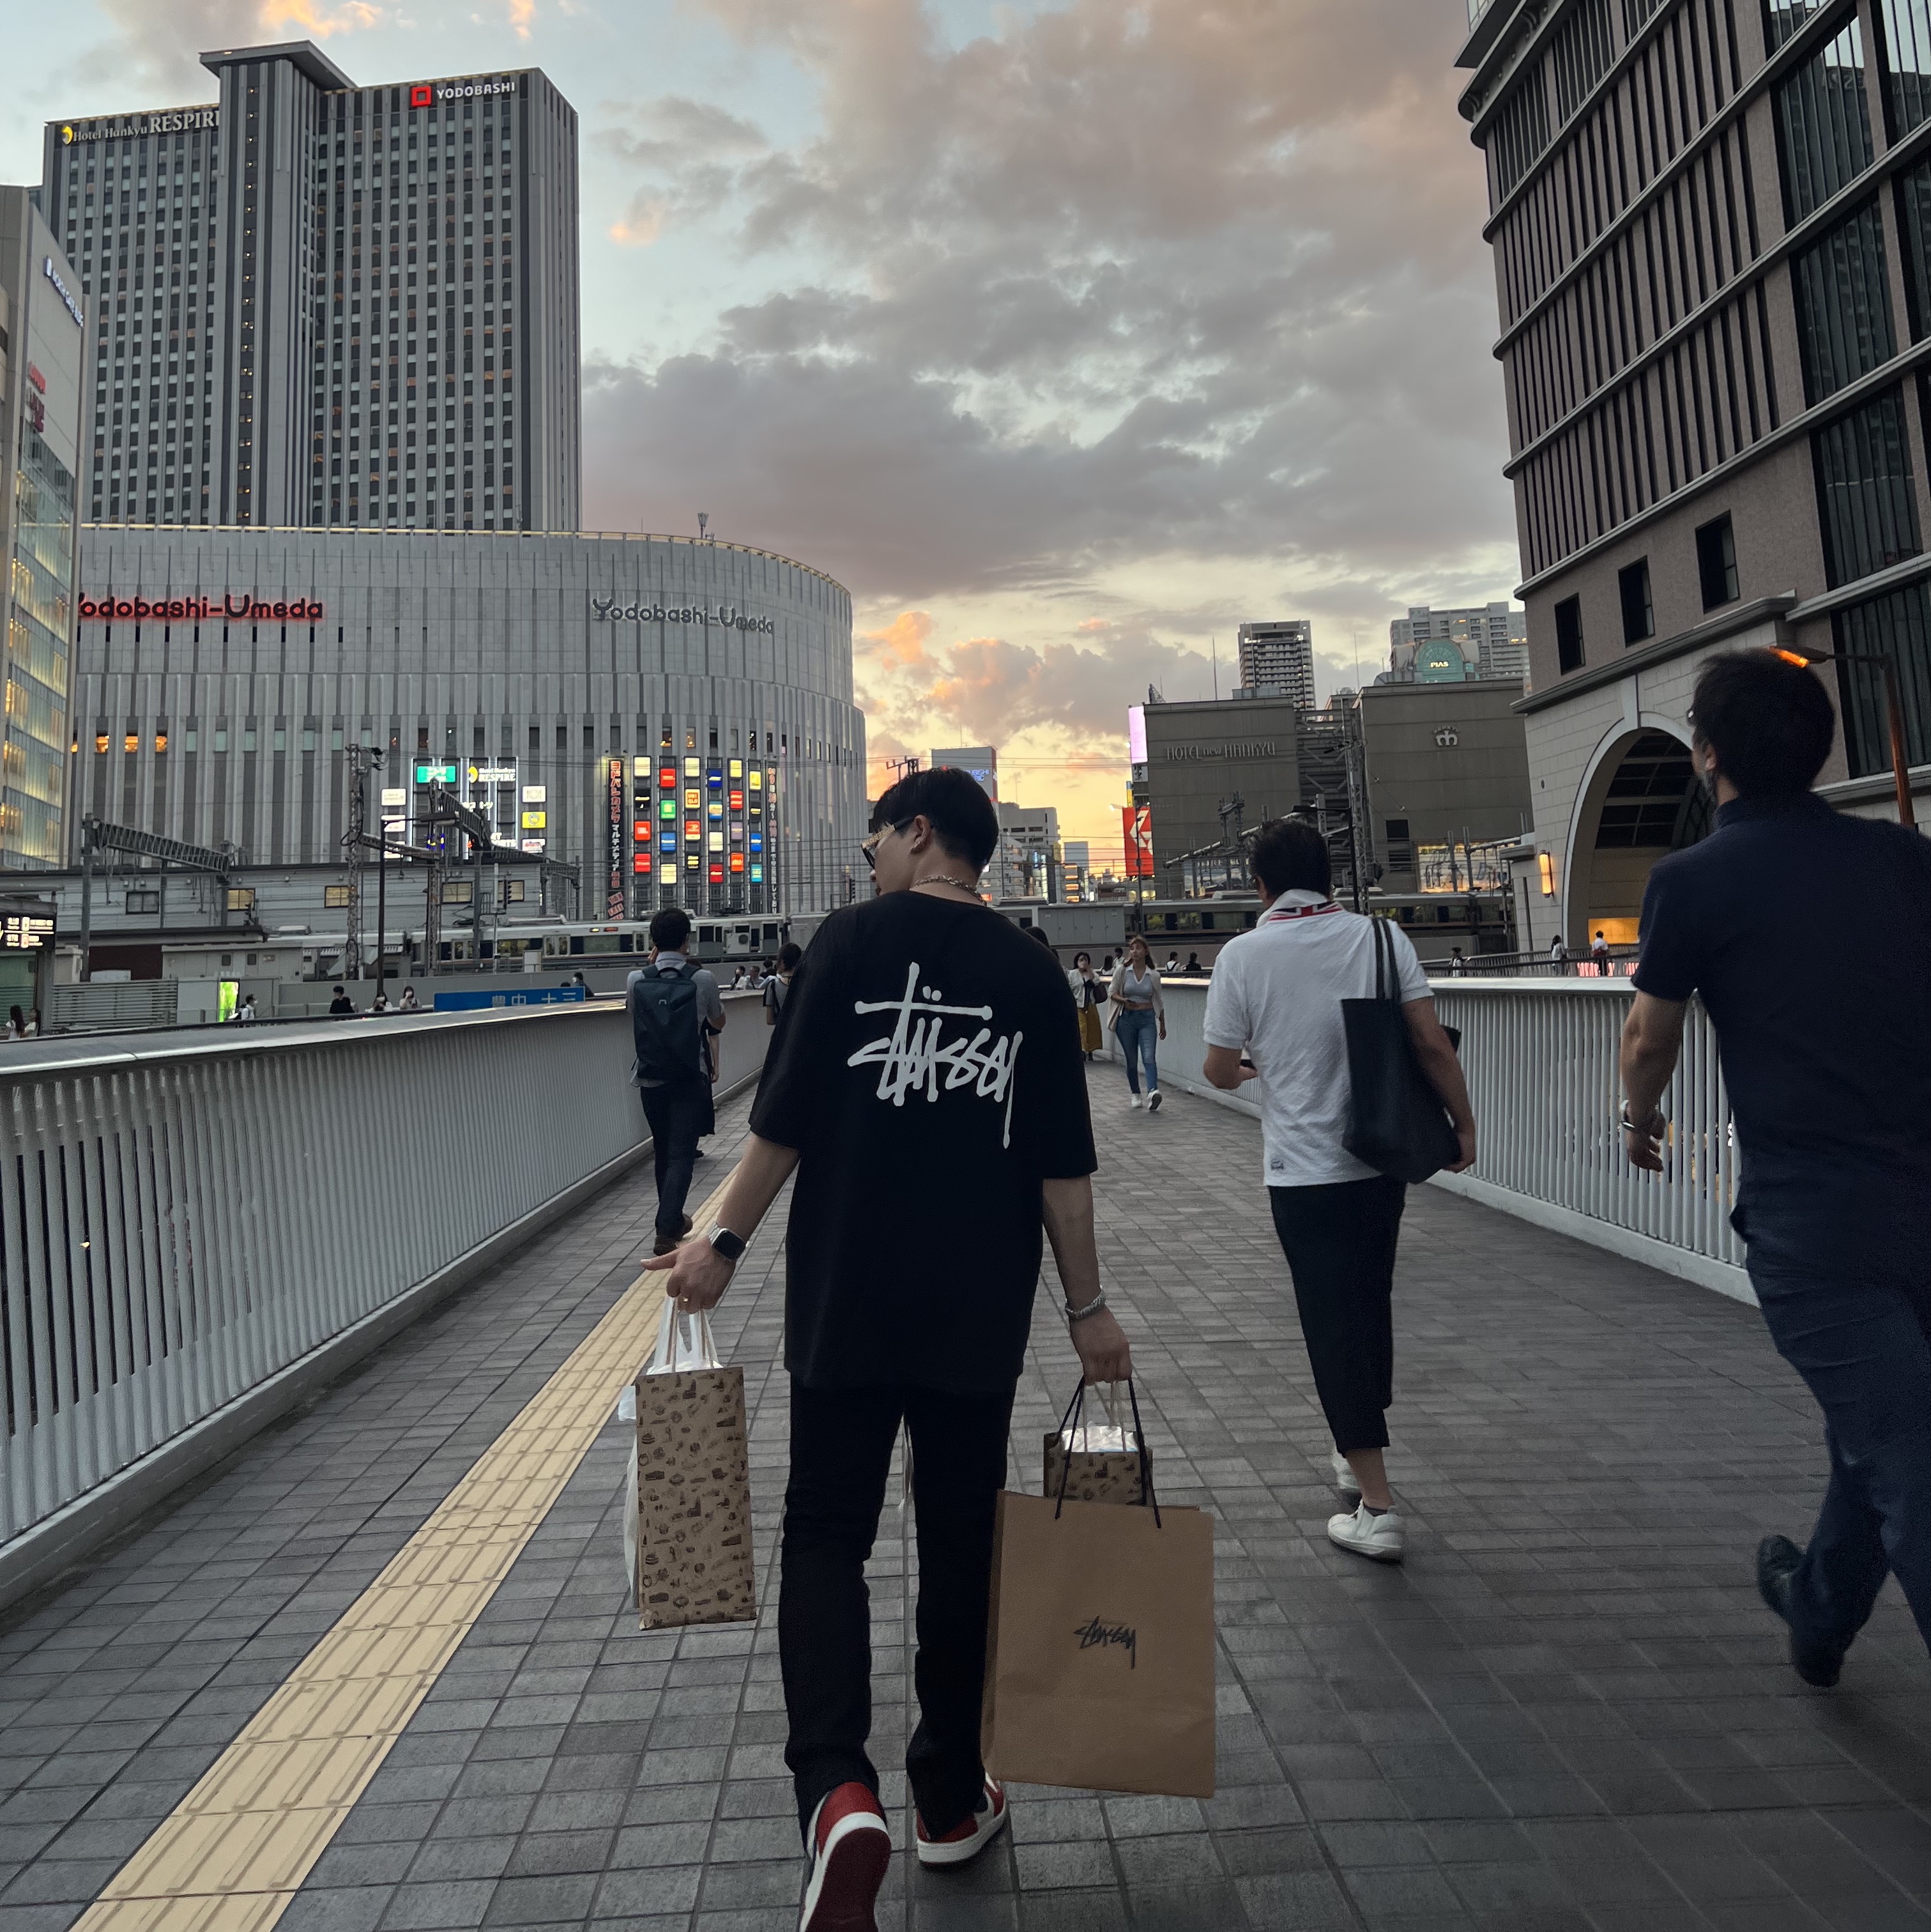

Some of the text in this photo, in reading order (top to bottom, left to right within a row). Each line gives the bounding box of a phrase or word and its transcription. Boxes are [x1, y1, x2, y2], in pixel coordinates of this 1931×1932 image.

[436, 81, 515, 100] YODOBASHI
[73, 130, 102, 142] Hotel
[105, 125, 148, 138] Hankyu
[79, 592, 323, 618] odobashi-Umeda
[592, 598, 775, 634] Yodobashi-Umeda
[1167, 742, 1276, 761] HOTEL new HANKYU
[478, 773, 516, 782] RESPIRE
